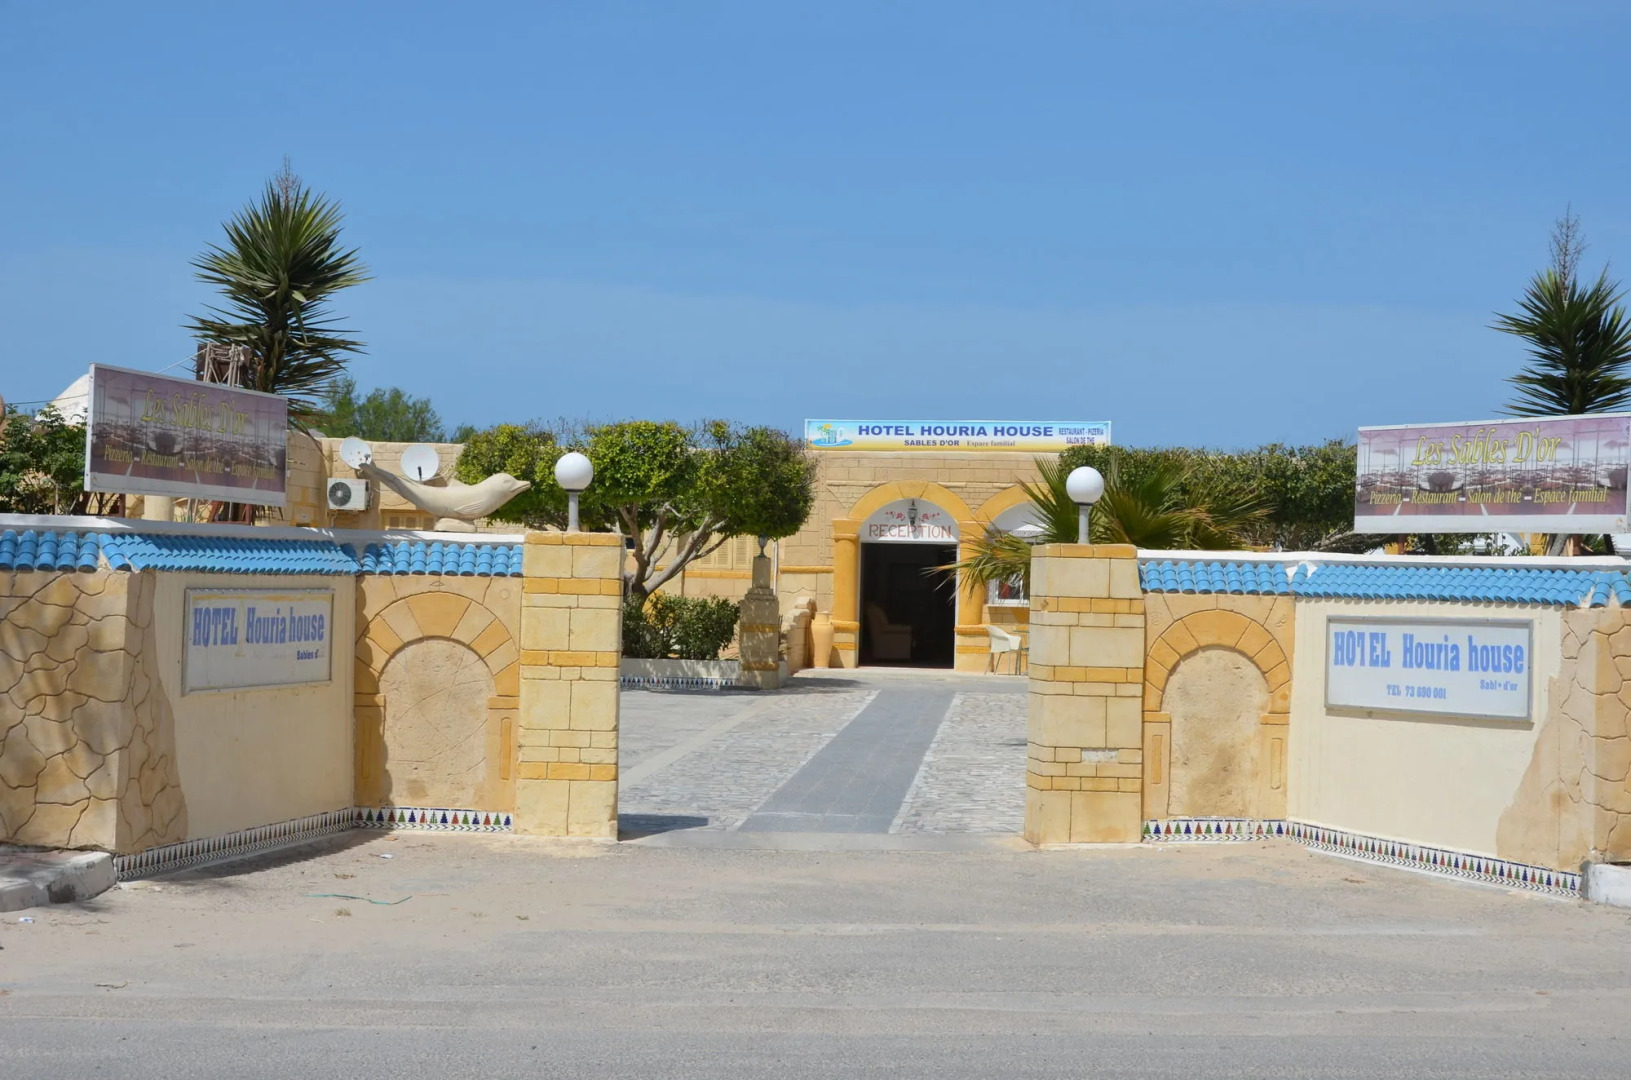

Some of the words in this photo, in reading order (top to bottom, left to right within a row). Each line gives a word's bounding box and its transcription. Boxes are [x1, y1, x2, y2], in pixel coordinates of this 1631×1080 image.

[141, 389, 166, 423] Les
[171, 392, 215, 432] Sables
[858, 425, 914, 436] HOTEL
[920, 425, 987, 437] HOURIA
[993, 426, 1053, 437] HOUSE
[904, 439, 937, 447] SABLES
[939, 439, 960, 447] D'OR
[967, 440, 989, 448] Espace
[1411, 435, 1443, 466] Les
[1447, 428, 1509, 465] Sables
[1512, 425, 1562, 463] D'or
[1411, 488, 1458, 505] Restaurant
[1467, 488, 1493, 504] Salon
[1493, 488, 1505, 504] de
[1533, 487, 1566, 506] Espace
[1567, 486, 1607, 505] familial
[868, 523, 952, 539] RECEPTION
[192, 606, 239, 648] HOTEL
[246, 606, 287, 644] Houria
[288, 606, 325, 642] house
[1333, 630, 1391, 668] HOTEL
[1402, 633, 1460, 672] Houria
[1467, 635, 1525, 674] house
[1404, 685, 1415, 697] 73
